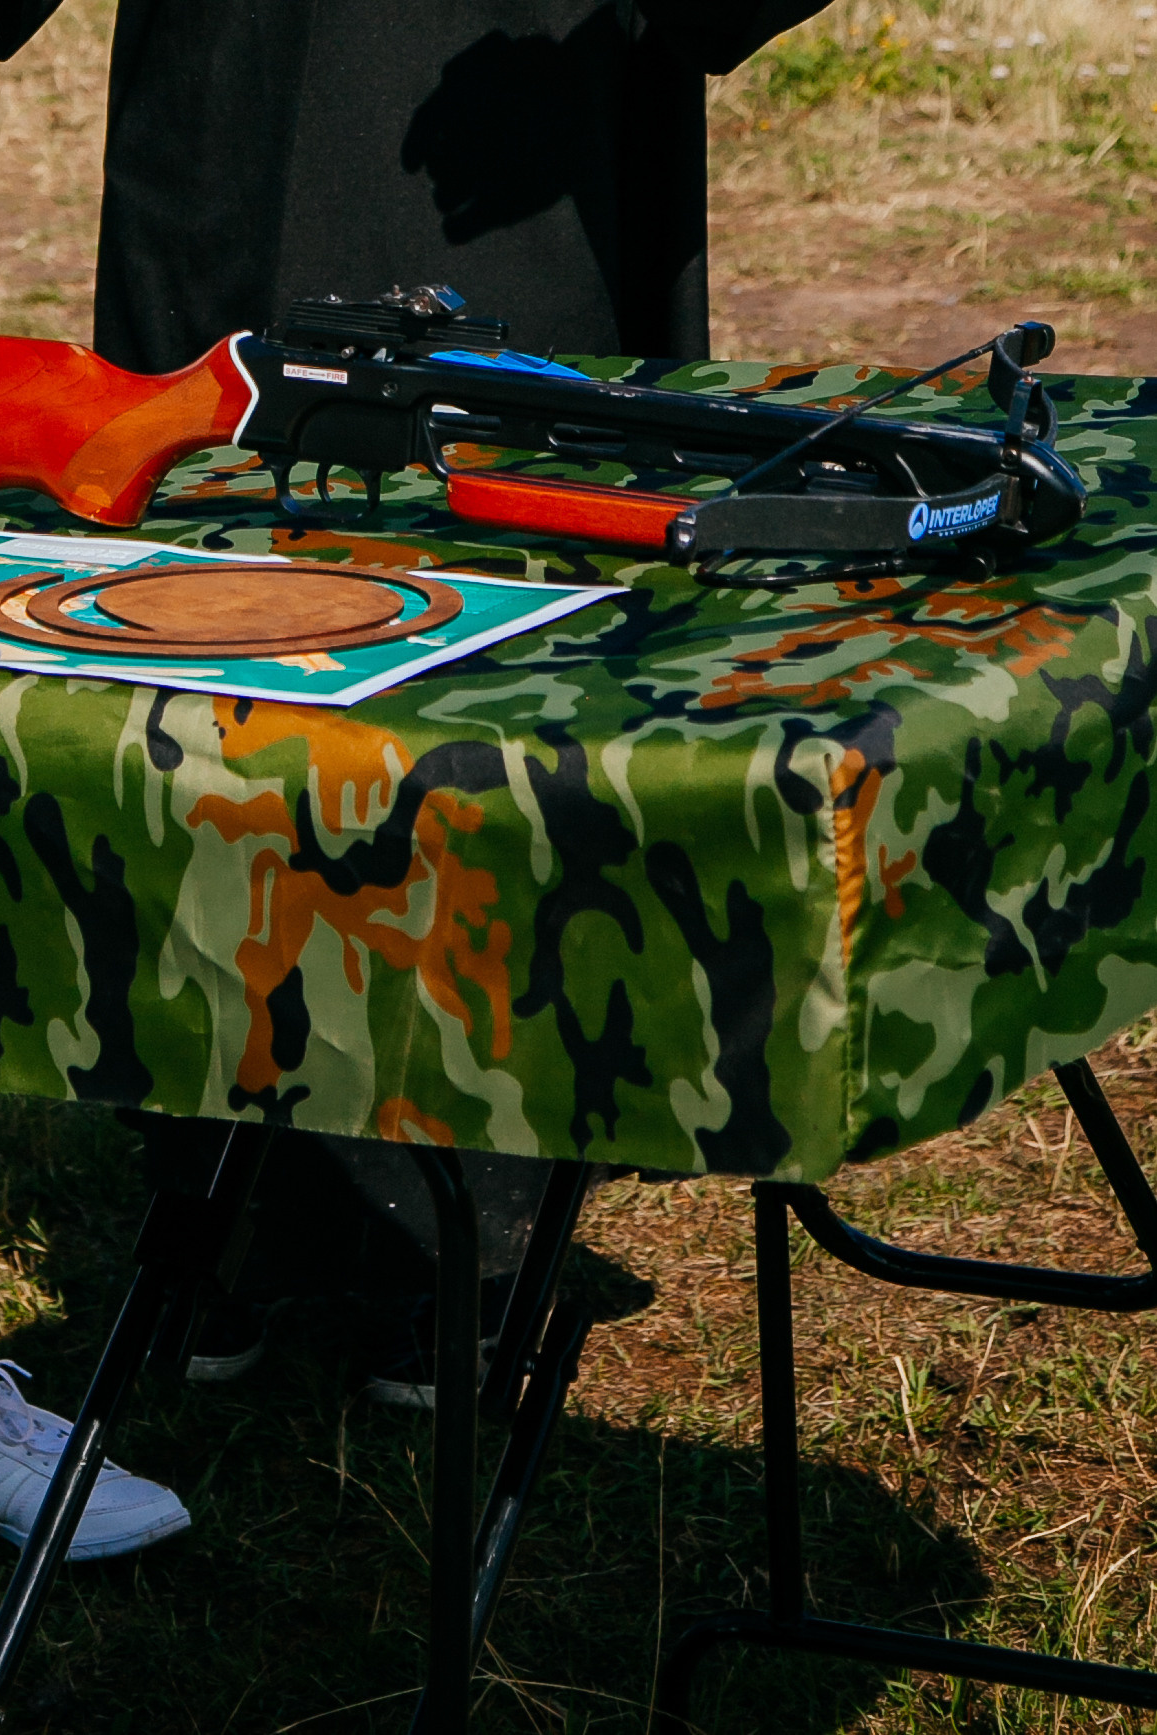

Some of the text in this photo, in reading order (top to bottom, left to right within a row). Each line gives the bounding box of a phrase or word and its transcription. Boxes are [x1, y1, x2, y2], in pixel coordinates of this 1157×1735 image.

[285, 367, 346, 382] SAFE FIRE
[928, 494, 1000, 529] INTERLOPER
